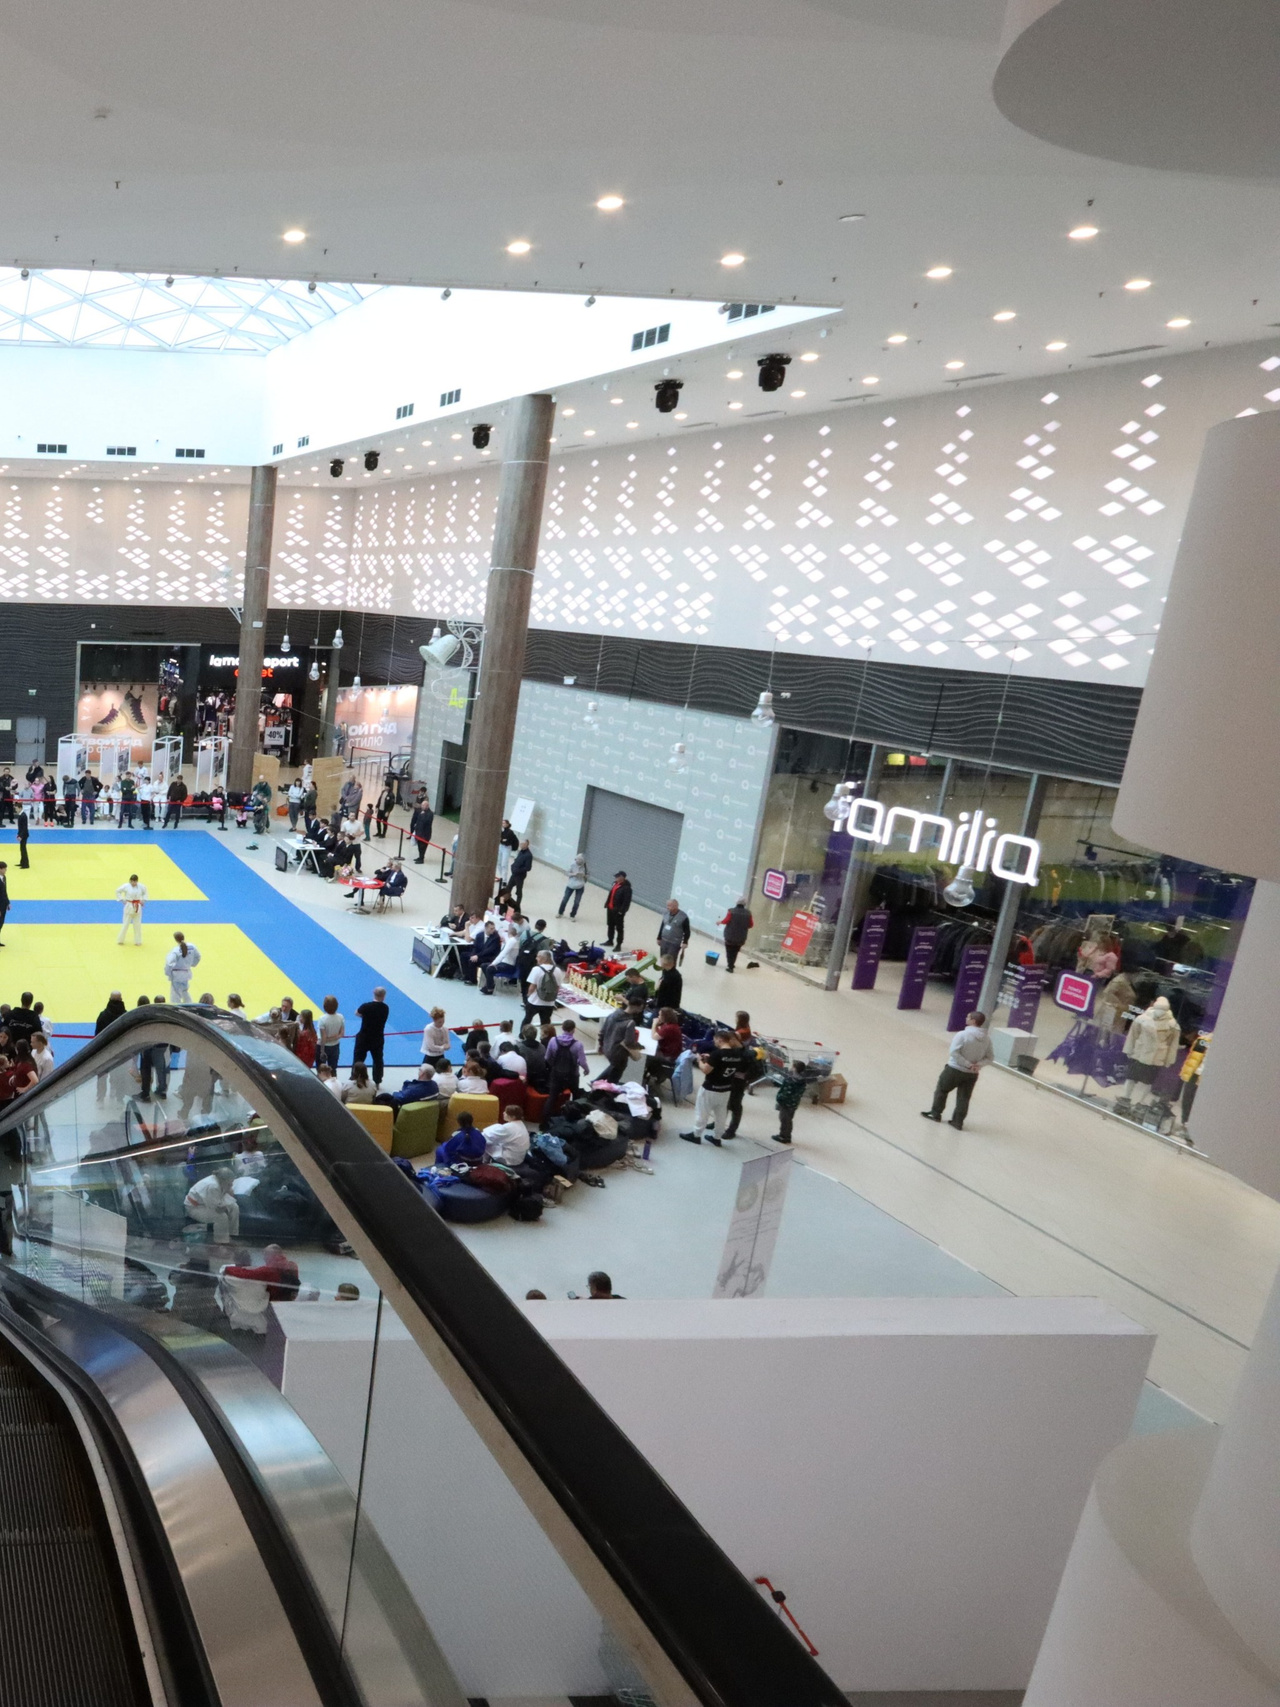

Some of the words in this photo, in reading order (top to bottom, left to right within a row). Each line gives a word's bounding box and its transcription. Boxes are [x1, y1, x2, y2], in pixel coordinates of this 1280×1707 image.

[209, 655, 239, 667] lam
[263, 656, 300, 669] sport
[234, 667, 274, 678] oet
[347, 736, 384, 749] СТИЛЮ
